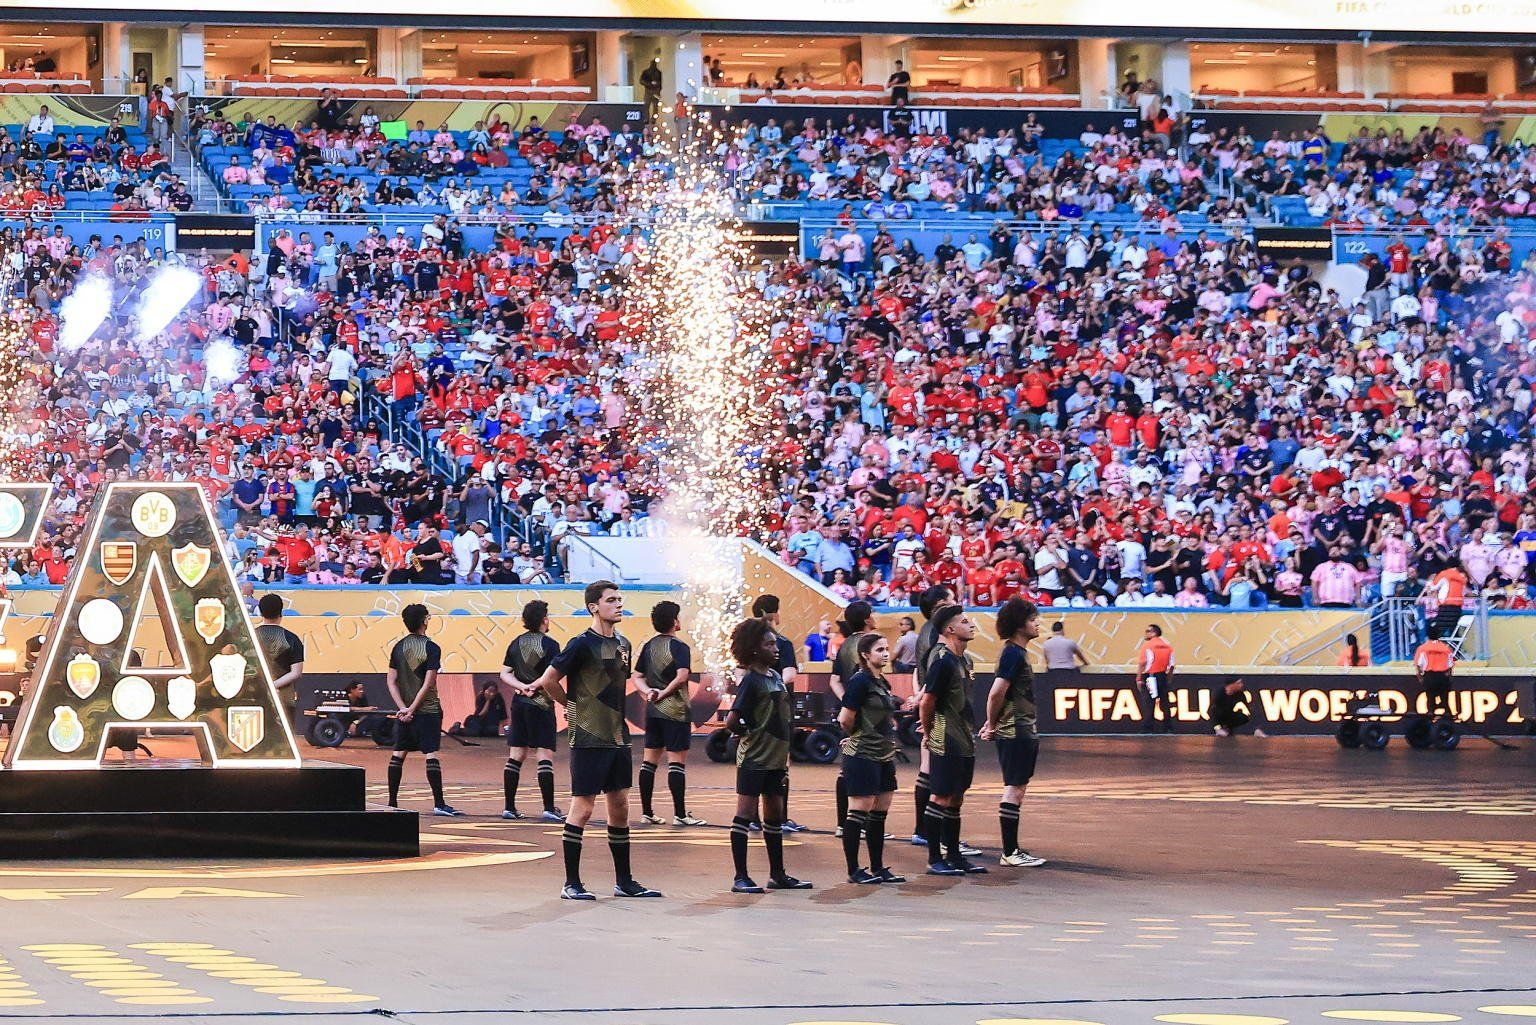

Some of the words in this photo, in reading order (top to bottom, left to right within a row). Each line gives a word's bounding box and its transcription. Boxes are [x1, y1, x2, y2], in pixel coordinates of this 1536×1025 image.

[626, 111, 640, 121] 220
[143, 228, 161, 240] 119
[1344, 241, 1368, 254] 122
[1054, 688, 1141, 721] FIFA
